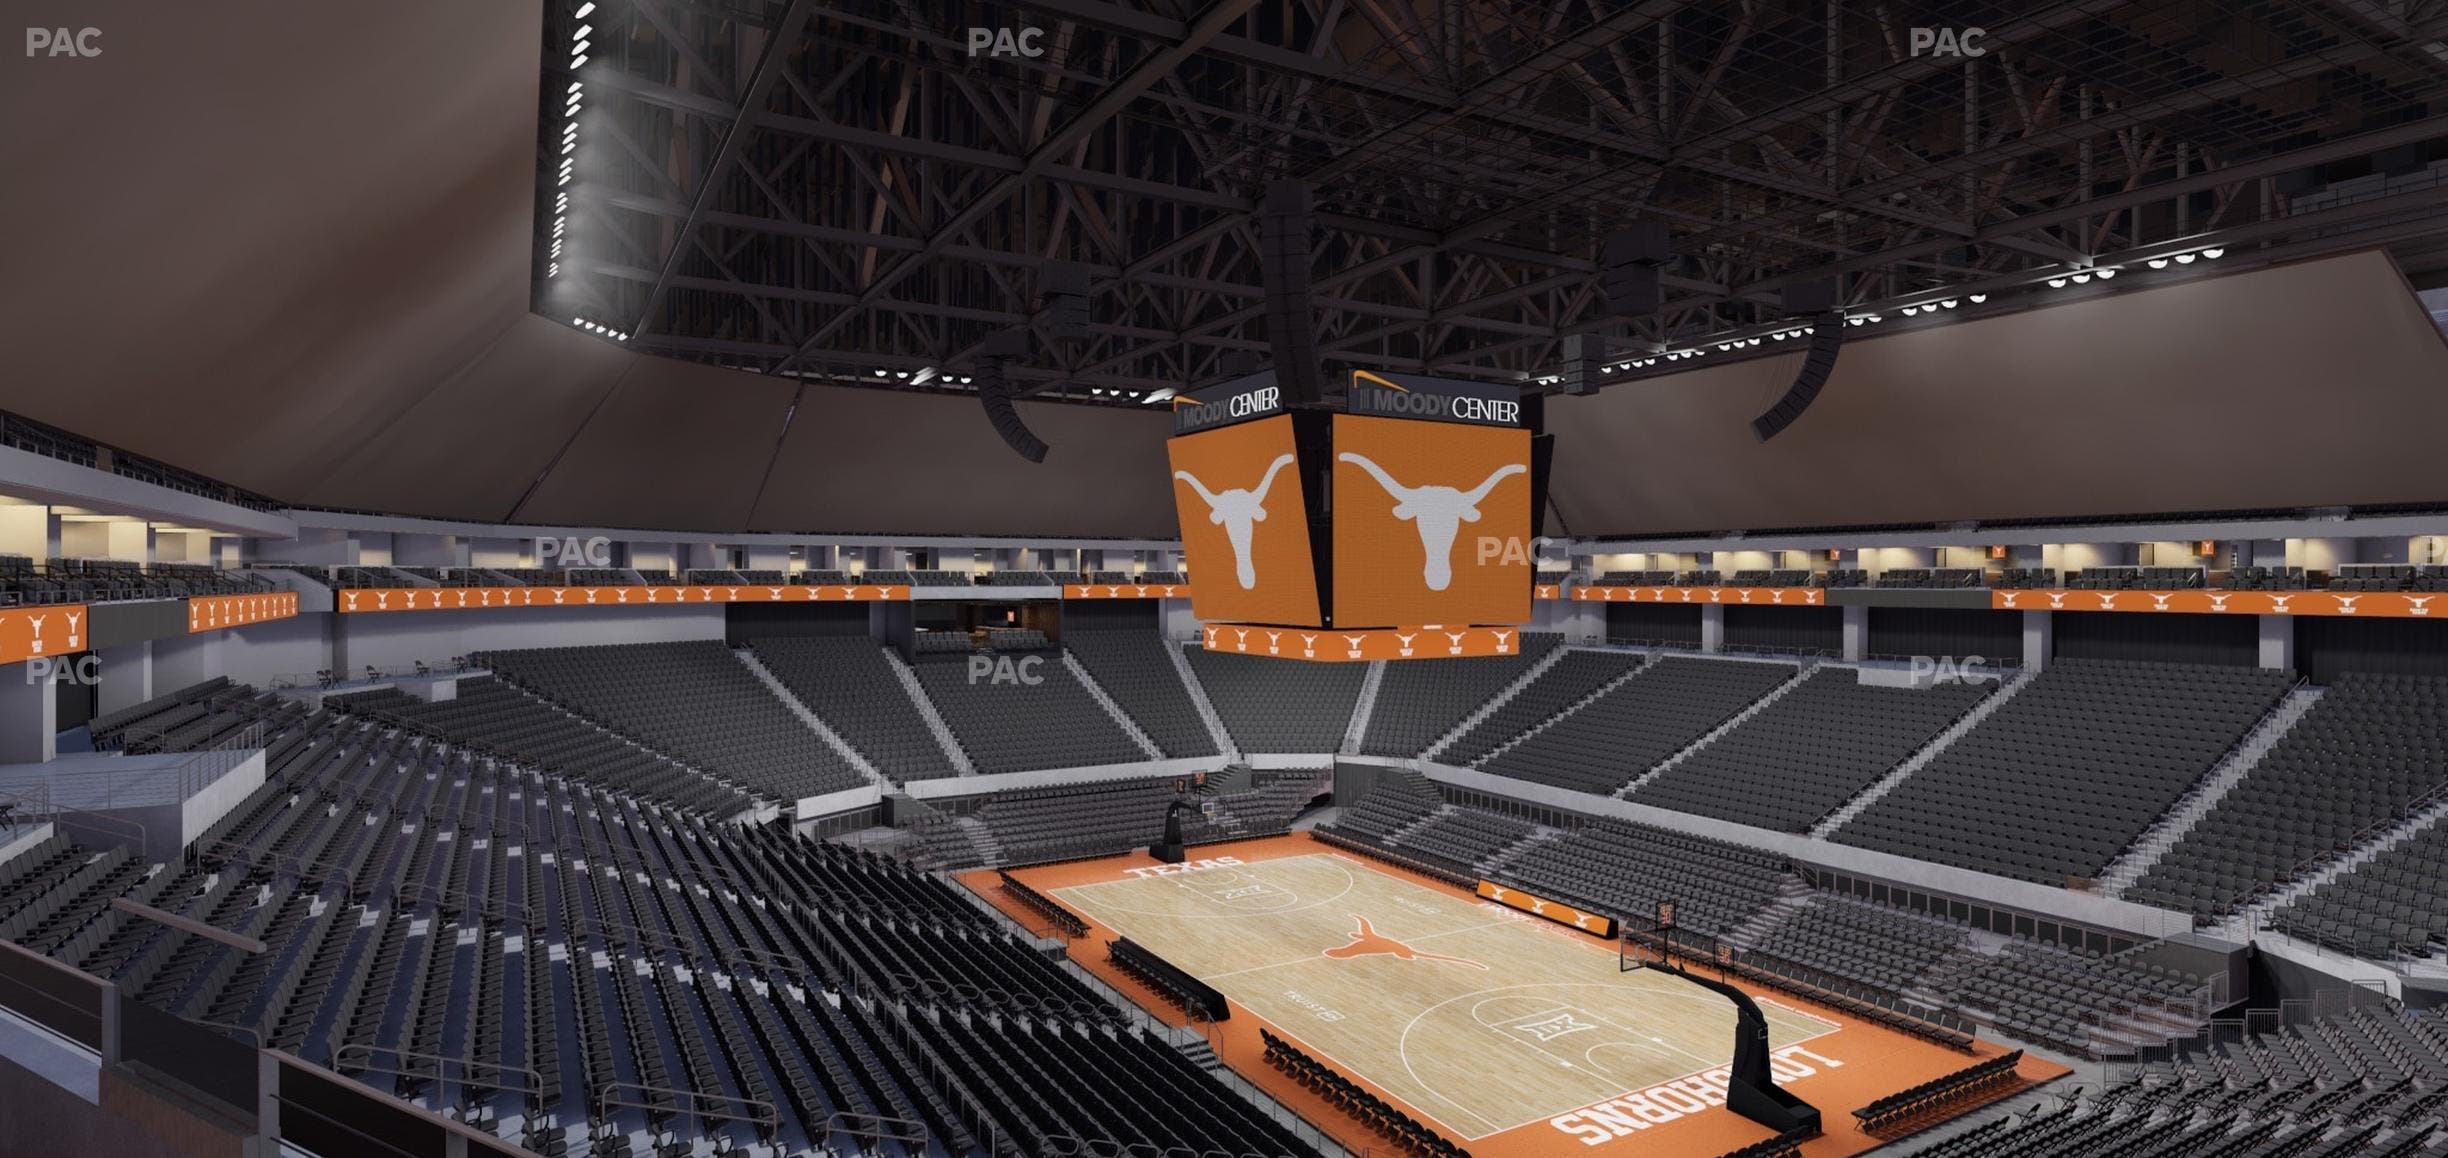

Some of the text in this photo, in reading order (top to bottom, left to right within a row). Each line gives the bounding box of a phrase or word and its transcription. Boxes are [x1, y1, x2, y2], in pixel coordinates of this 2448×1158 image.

[1183, 386, 1279, 428] MOODY CENTER
[1373, 388, 1519, 423] MOODY CENTER
[1122, 856, 1245, 878] TEXAS
[1550, 1045, 1844, 1146] LOHORNS
